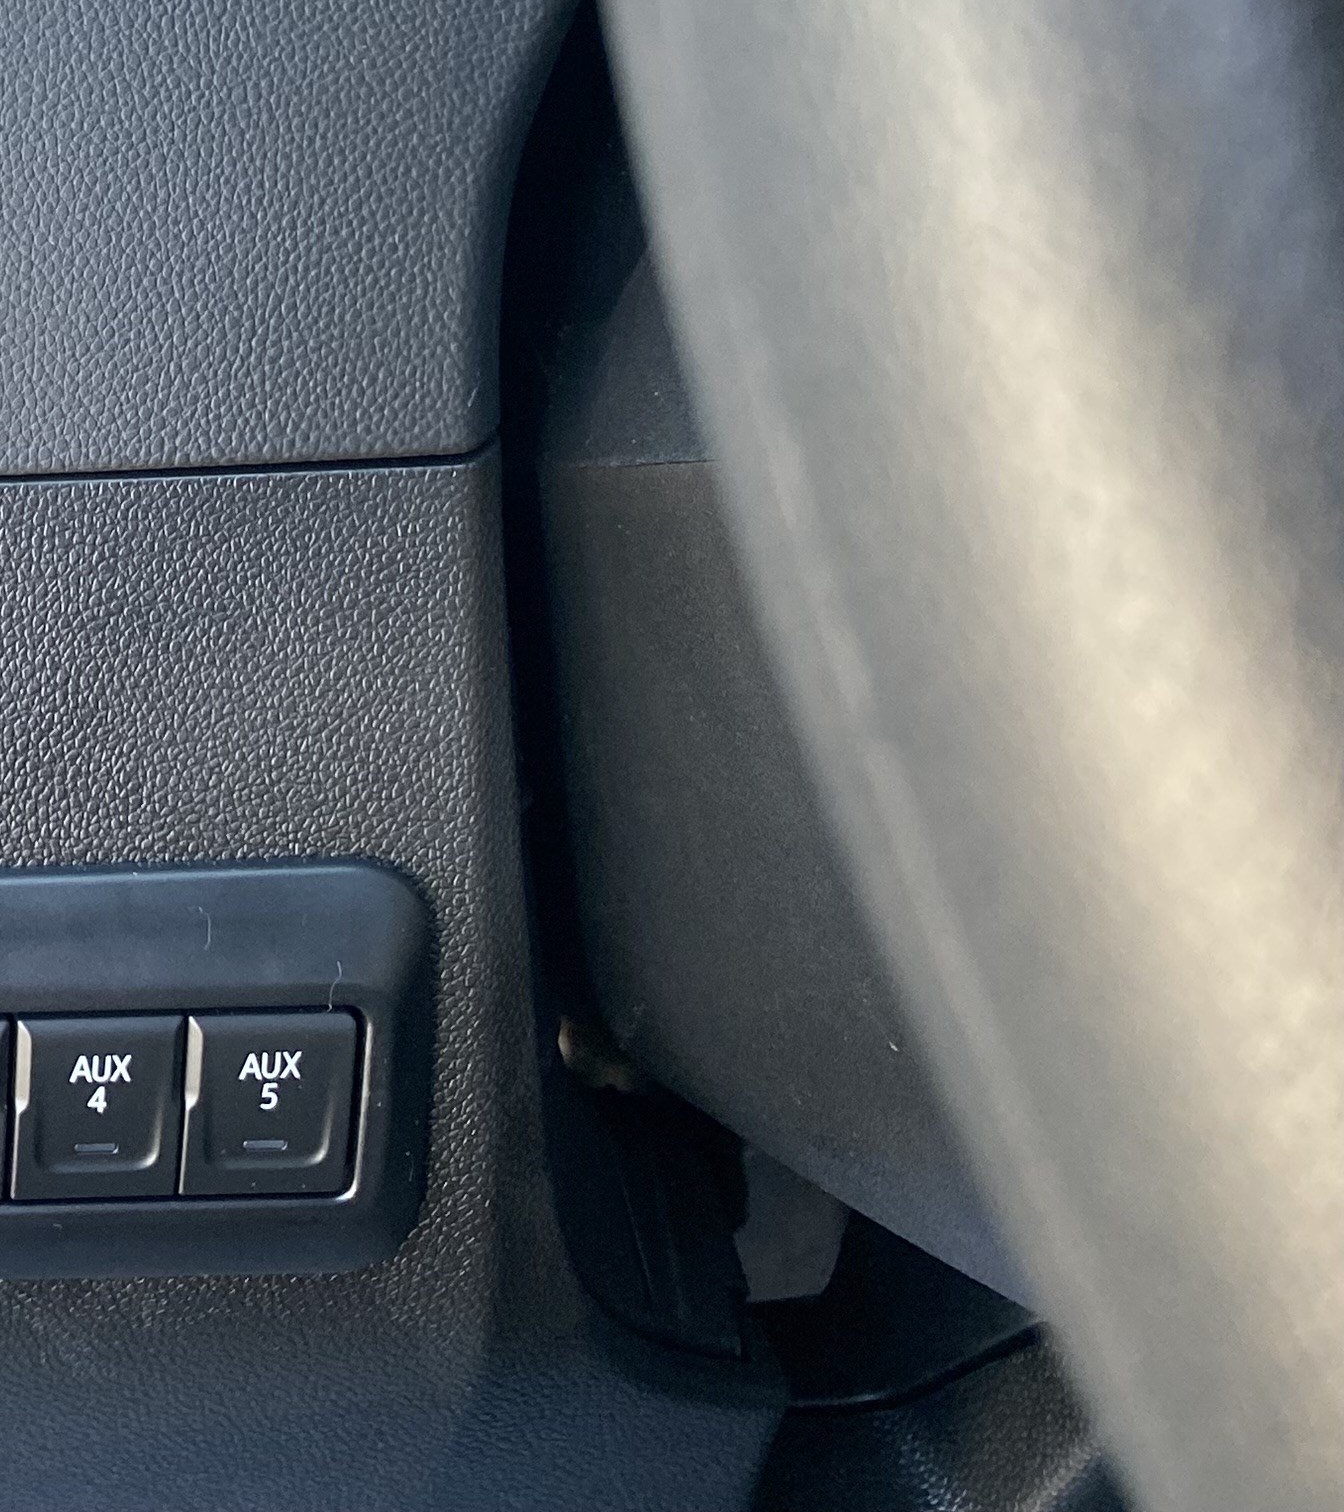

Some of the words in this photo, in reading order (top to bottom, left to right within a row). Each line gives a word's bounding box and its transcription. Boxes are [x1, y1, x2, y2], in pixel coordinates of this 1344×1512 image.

[69, 1054, 132, 1084] AUX
[238, 1050, 303, 1081] AUX
[87, 1085, 107, 1114] 4
[259, 1082, 279, 1110] 5
